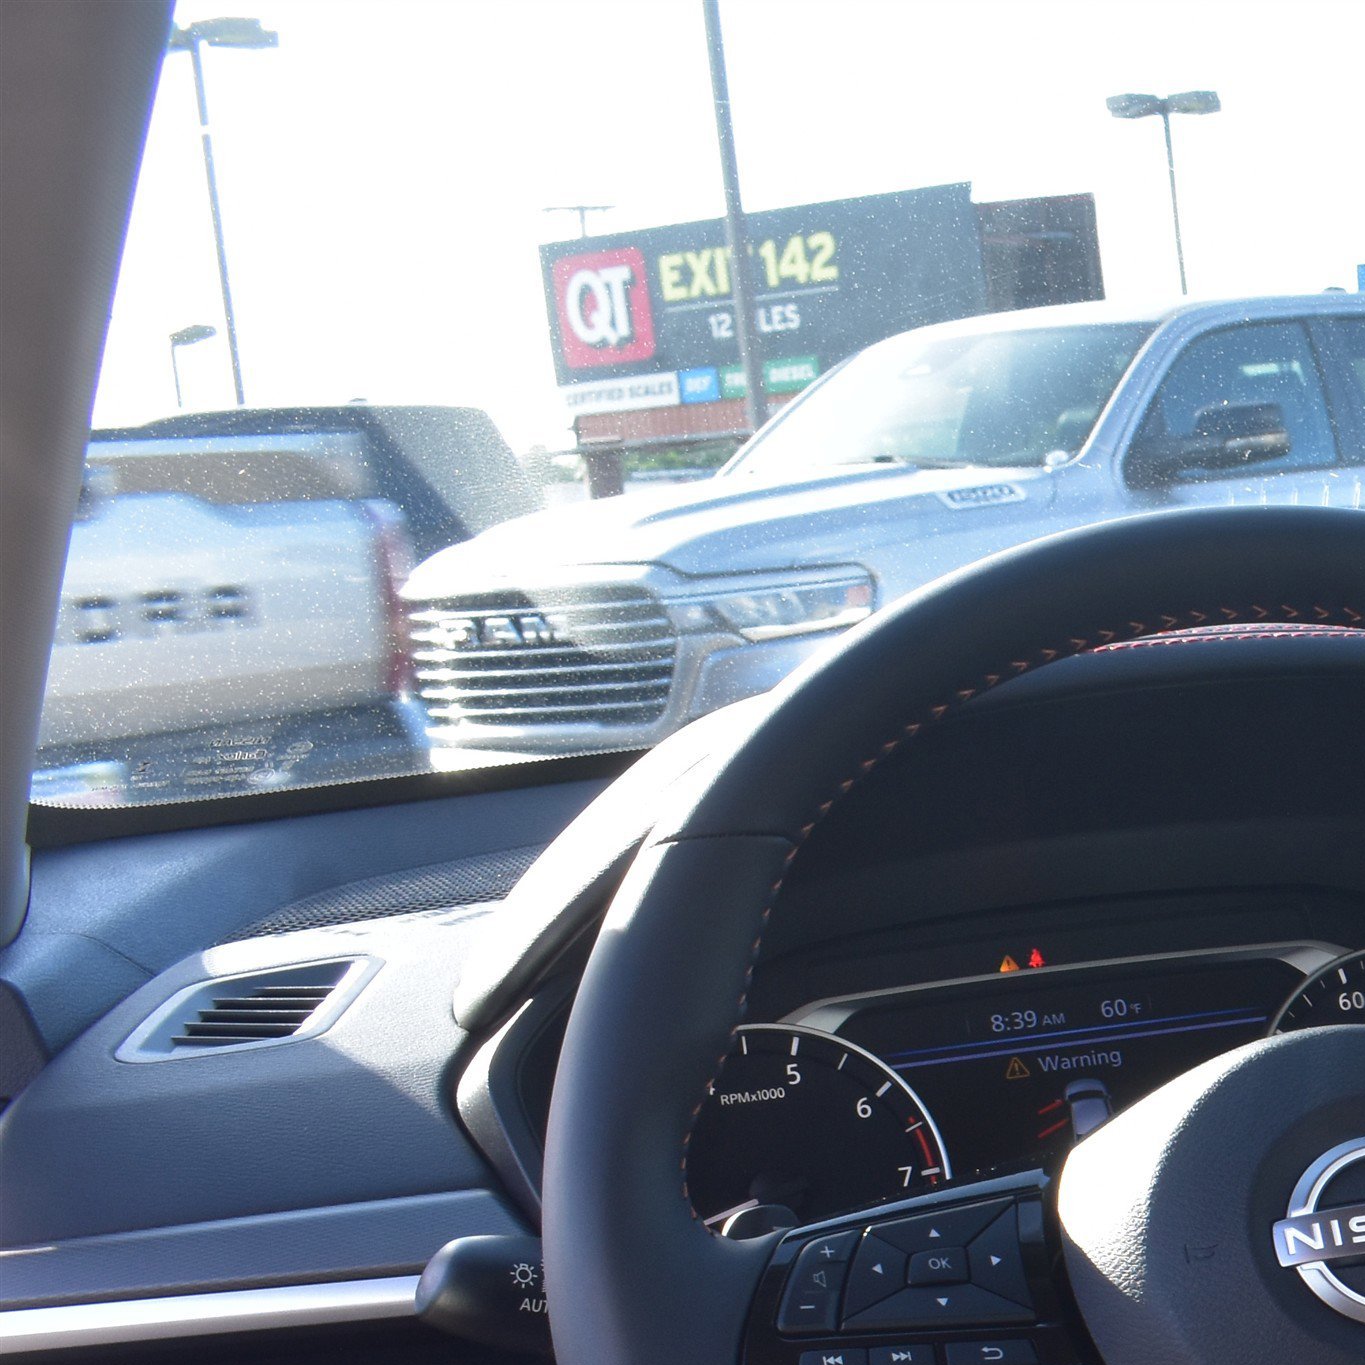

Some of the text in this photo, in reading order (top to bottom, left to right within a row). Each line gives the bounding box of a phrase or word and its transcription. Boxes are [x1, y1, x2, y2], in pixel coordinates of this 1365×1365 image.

[758, 231, 840, 288] 142
[566, 265, 632, 346] QT
[707, 303, 801, 339] 12 LES
[1101, 998, 1128, 1018] 60
[1338, 991, 1365, 1012] 60
[990, 1010, 1066, 1033] 8:39 AM
[1037, 1050, 1123, 1073] Warning
[786, 1063, 802, 1085] 5
[720, 1086, 786, 1106] RPMx1000
[856, 1097, 873, 1119] 6
[897, 1164, 913, 1188] 7
[928, 1256, 952, 1270] OK
[519, 1298, 549, 1314] AUT
